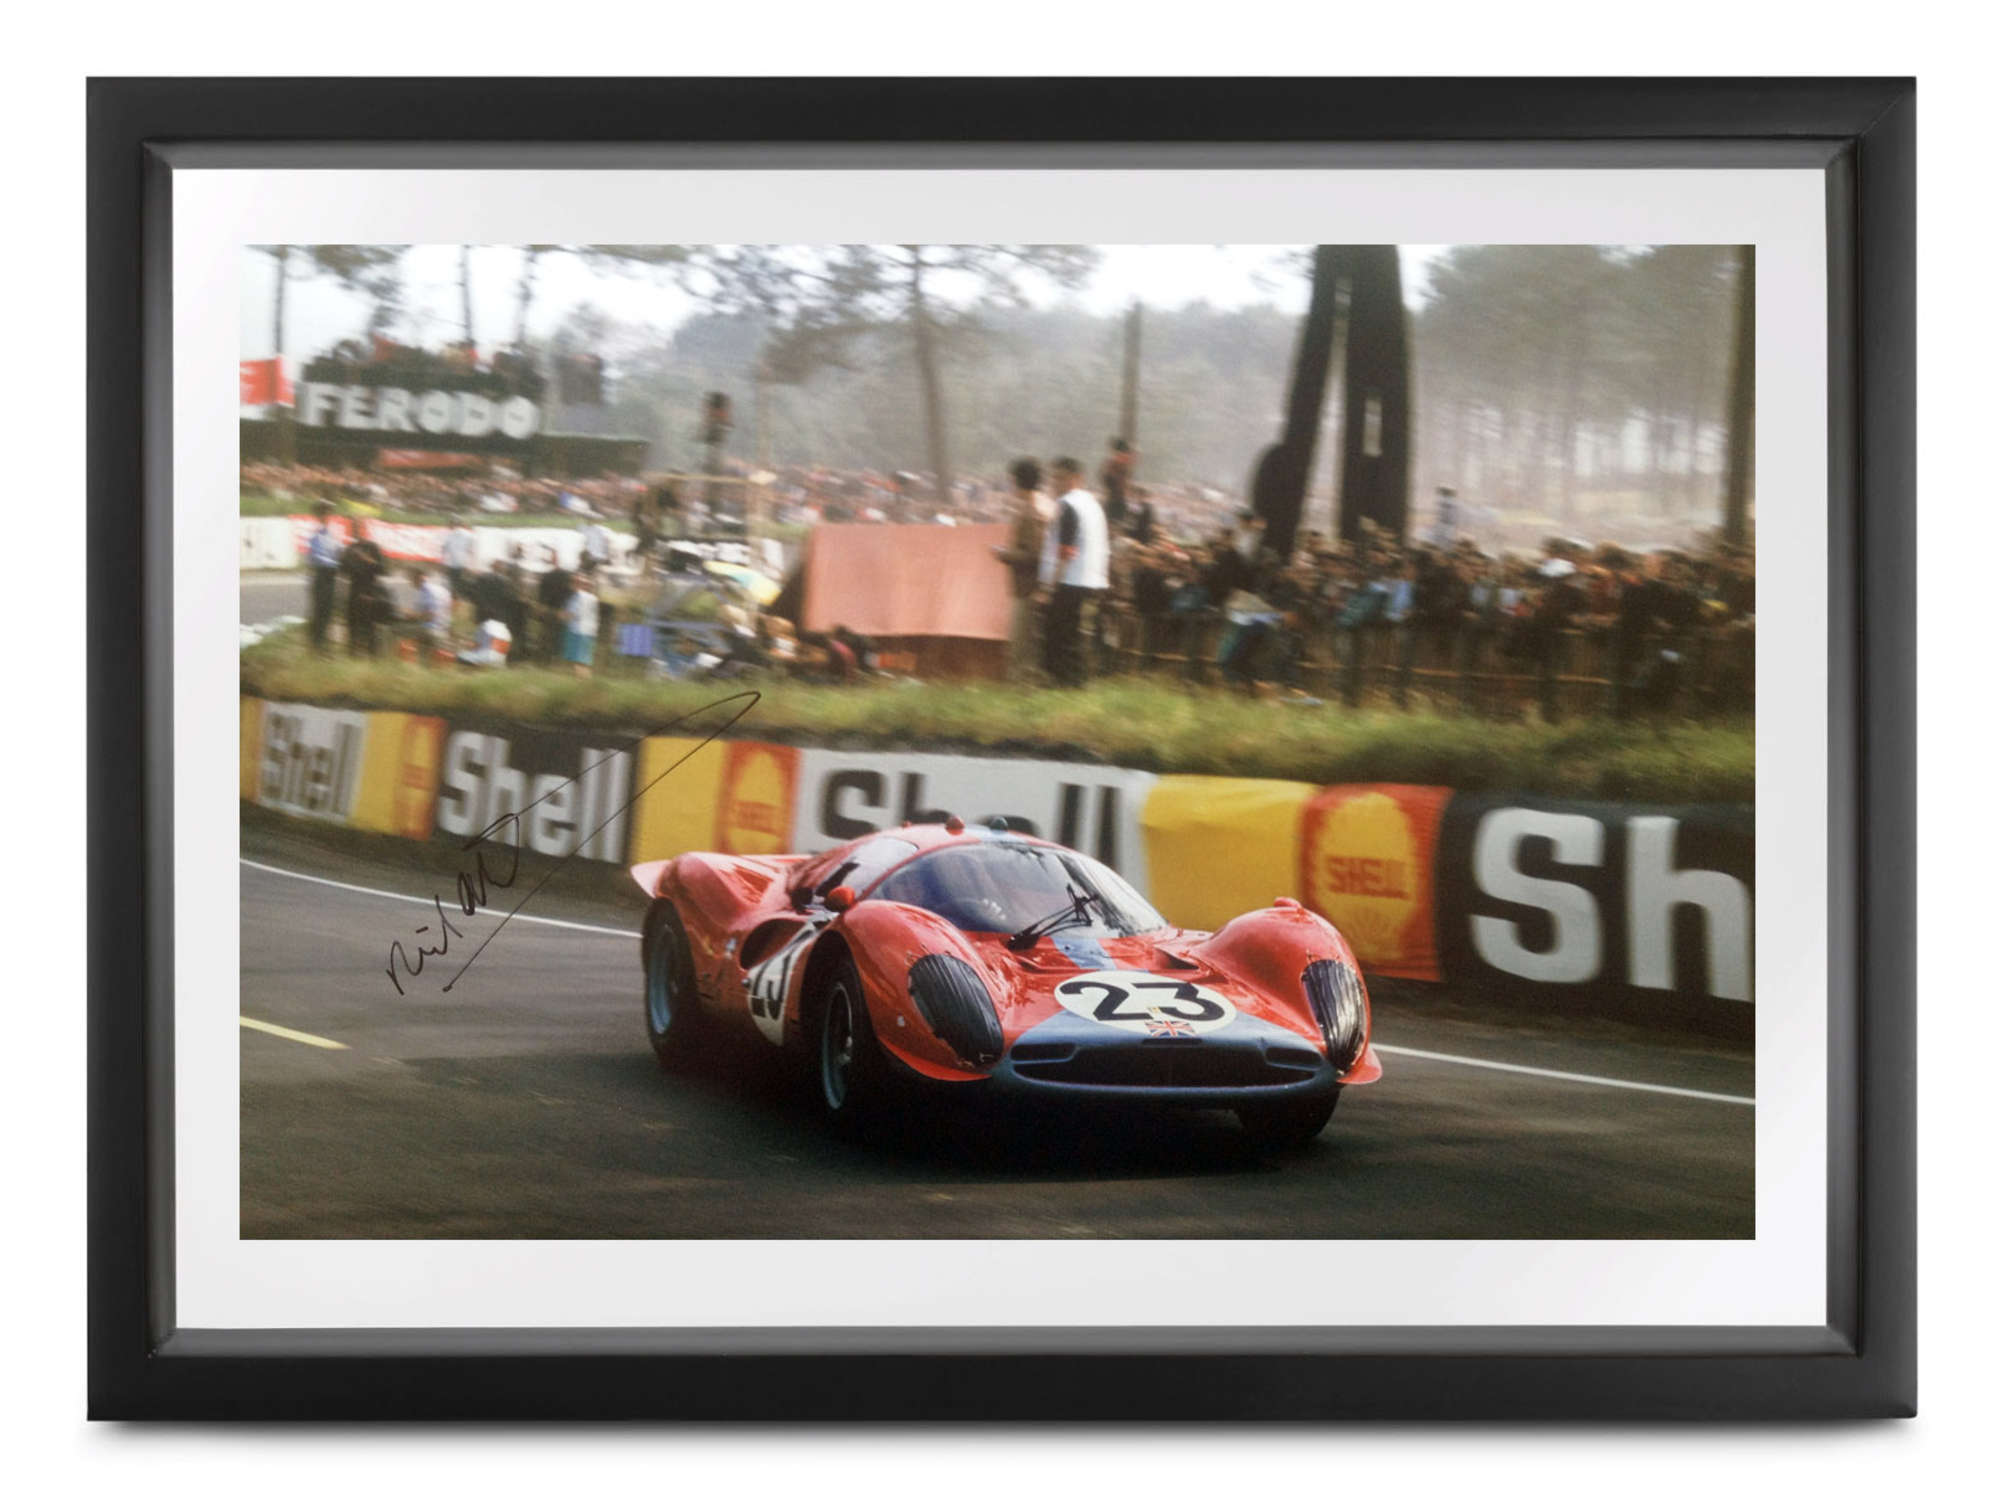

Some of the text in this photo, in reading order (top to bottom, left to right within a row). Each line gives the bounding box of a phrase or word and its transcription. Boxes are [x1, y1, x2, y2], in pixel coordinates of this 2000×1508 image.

[302, 382, 540, 439] FERODO
[260, 712, 362, 816] Shell
[436, 730, 632, 864] Shell
[1470, 806, 1756, 1003] Sh
[1059, 981, 1225, 1021] 23
